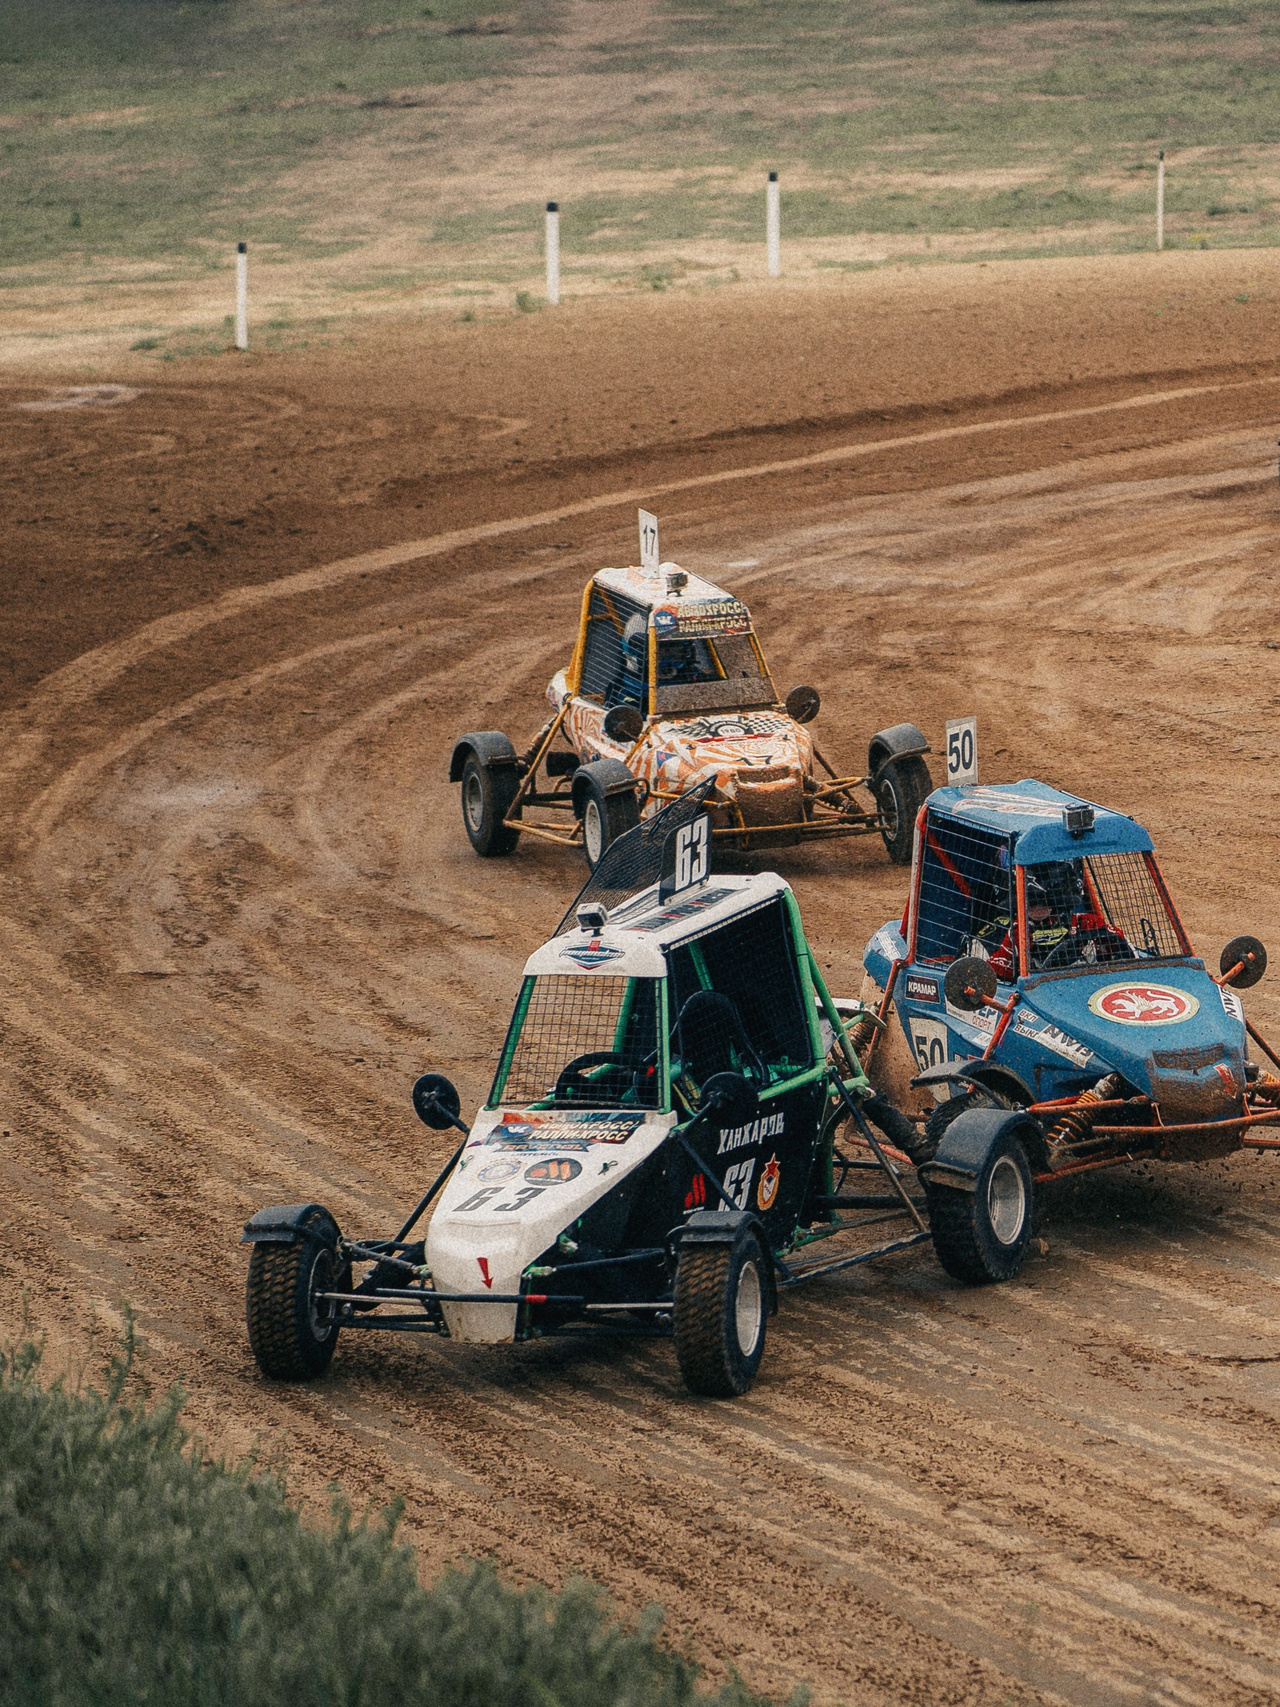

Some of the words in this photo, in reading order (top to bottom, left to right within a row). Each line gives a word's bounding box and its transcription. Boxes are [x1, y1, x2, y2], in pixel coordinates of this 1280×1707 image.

[643, 525, 656, 556] 17
[948, 729, 973, 774] 50
[675, 815, 708, 891] 63
[908, 981, 937, 996] КРАМАР
[1019, 1010, 1038, 1022] ВКЛ
[915, 1035, 945, 1071] 50
[502, 1143, 584, 1151] RAVENOL
[452, 1186, 548, 1212] 63
[718, 1158, 756, 1212] 63
